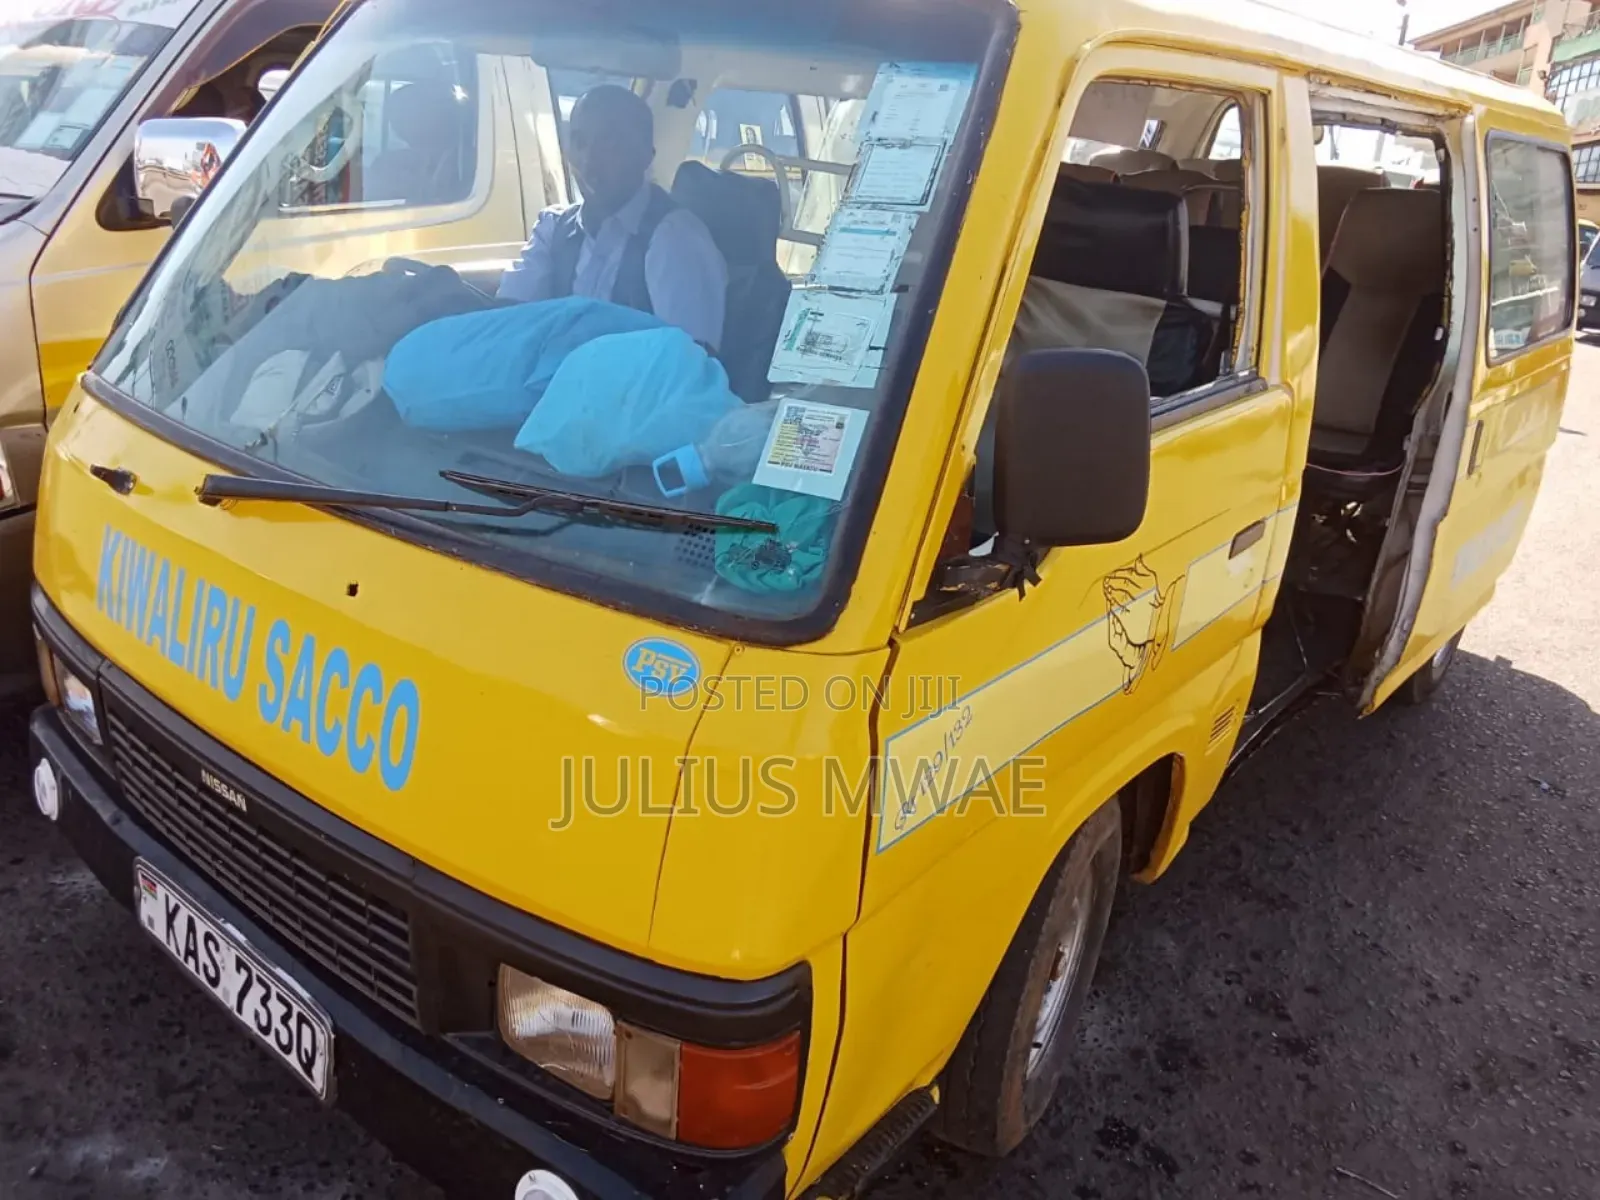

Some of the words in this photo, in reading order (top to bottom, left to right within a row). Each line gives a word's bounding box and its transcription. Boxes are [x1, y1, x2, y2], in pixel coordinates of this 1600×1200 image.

[97, 523, 256, 702] KIWALIRU
[258, 618, 420, 791] SACCO
[632, 648, 690, 683] PSV
[201, 769, 247, 813] NISSAN
[165, 893, 221, 989] KAS
[235, 953, 317, 1082] 733Q
